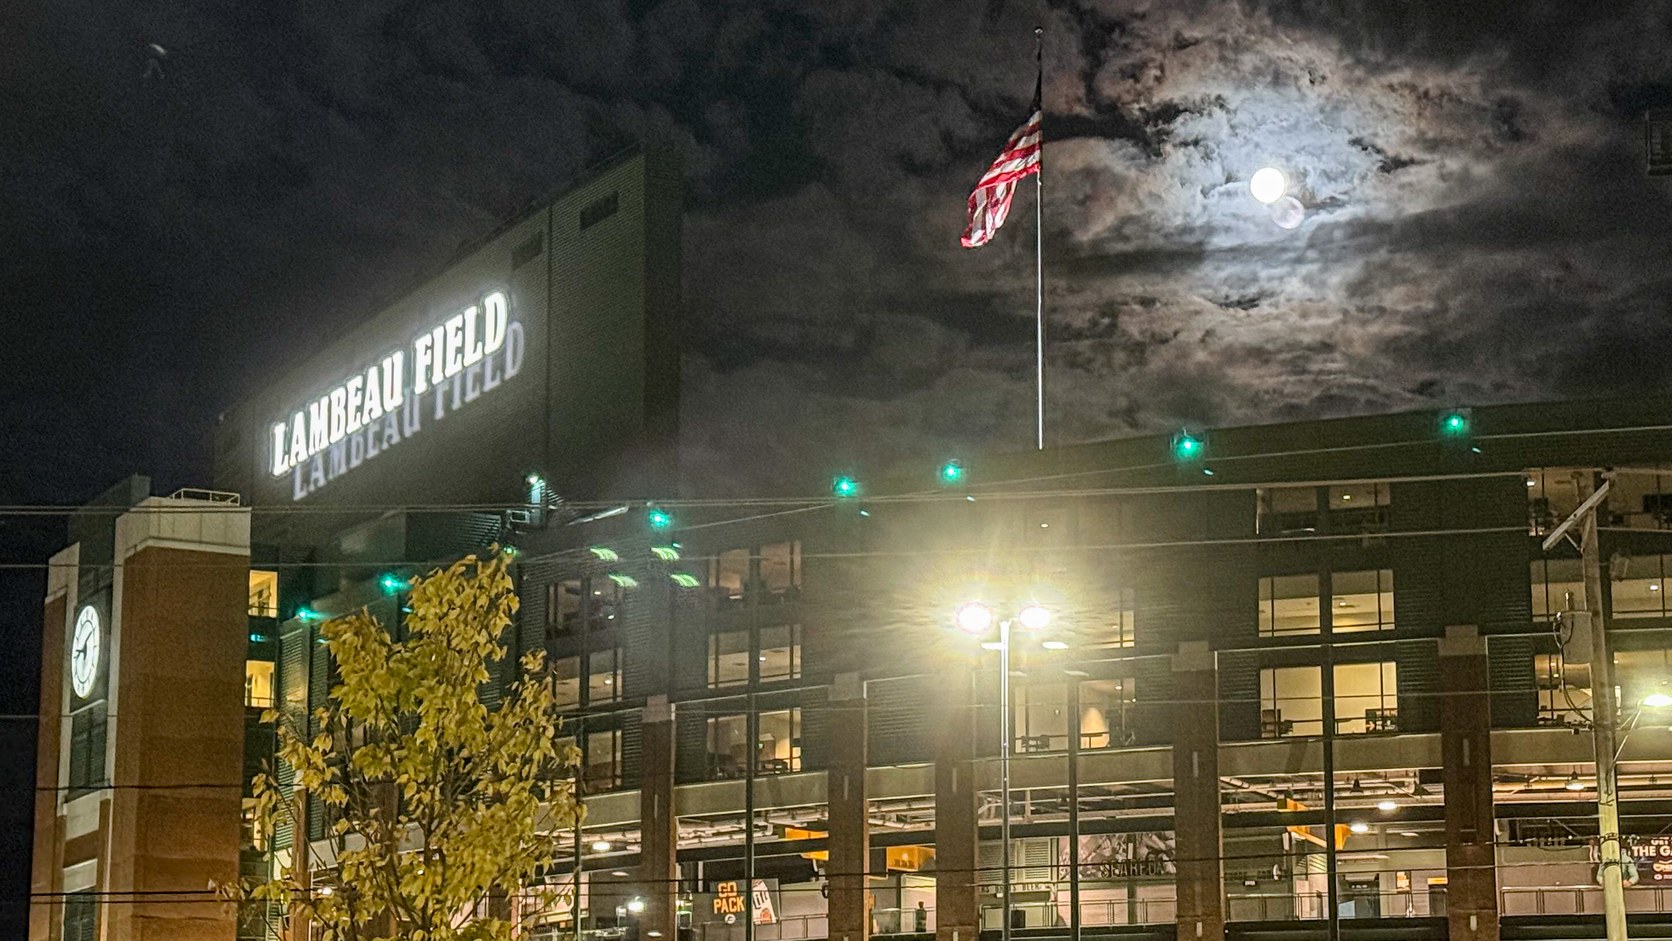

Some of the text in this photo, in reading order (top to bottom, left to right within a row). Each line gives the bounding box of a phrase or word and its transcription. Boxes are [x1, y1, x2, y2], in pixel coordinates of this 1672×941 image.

[270, 291, 509, 478] LAMBEAU FIELD
[1631, 845, 1657, 857] THE
[718, 881, 737, 897] GO
[713, 897, 745, 914] PACK
